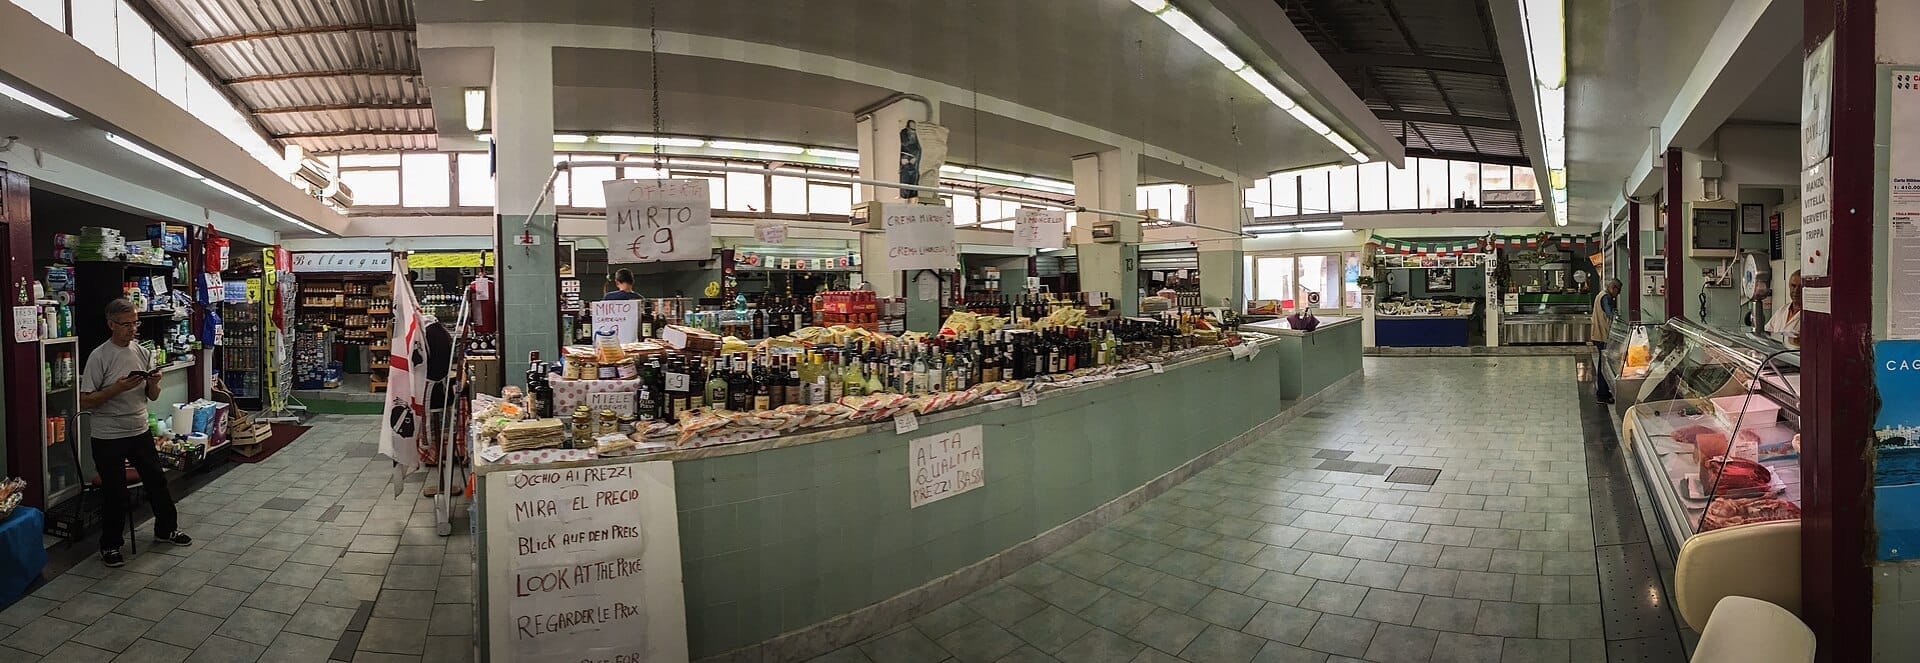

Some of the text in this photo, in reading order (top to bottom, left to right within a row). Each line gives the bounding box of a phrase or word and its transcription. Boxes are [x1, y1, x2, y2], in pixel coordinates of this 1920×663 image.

[1806, 176, 1824, 192] MANZO
[1804, 193, 1826, 208] VITELLA
[617, 206, 691, 232] MIRTO
[1806, 227, 1824, 240] TRIPPA
[1488, 259, 1497, 268] 10
[595, 303, 631, 316] MIRTO
[592, 394, 629, 404] MIELE
[917, 432, 961, 466] ALTA
[514, 466, 632, 489] OCCHIO AI PREZZI
[913, 480, 952, 503] PREZZI
[515, 489, 639, 522] MIRA EL PRECIO
[563, 531, 585, 545] AUF
[589, 529, 609, 542] DEN
[612, 525, 639, 540] PREIS
[516, 558, 643, 597] LOOK AT THE PRICE
[517, 602, 639, 640] REGARDER LE PRIX
